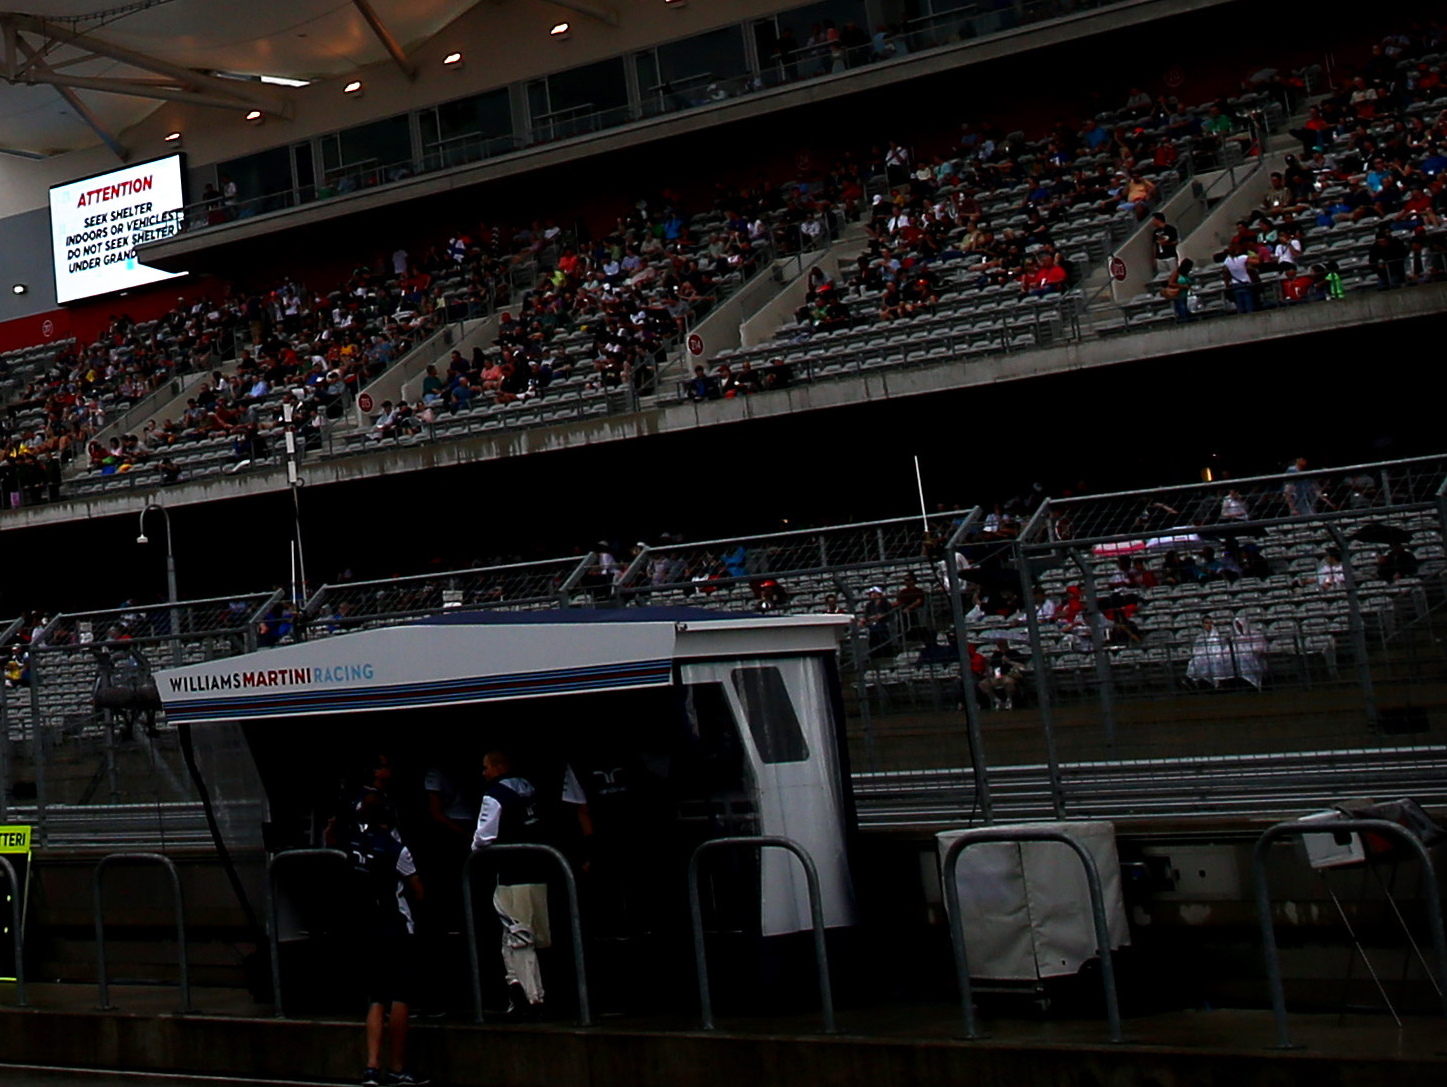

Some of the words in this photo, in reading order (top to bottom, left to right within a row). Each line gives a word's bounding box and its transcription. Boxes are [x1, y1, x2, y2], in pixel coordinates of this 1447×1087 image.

[77, 174, 153, 208] ATTENTION
[66, 228, 108, 246] INDOORS
[110, 224, 124, 235] OR
[127, 211, 174, 231] VEHICLES
[84, 213, 107, 228] SEEK
[110, 202, 153, 222] SHELTER
[67, 248, 81, 260] DO
[83, 242, 102, 256] NOT
[105, 236, 129, 251] SEEK
[132, 224, 174, 245] SHELTER
[69, 257, 101, 273] UNDER
